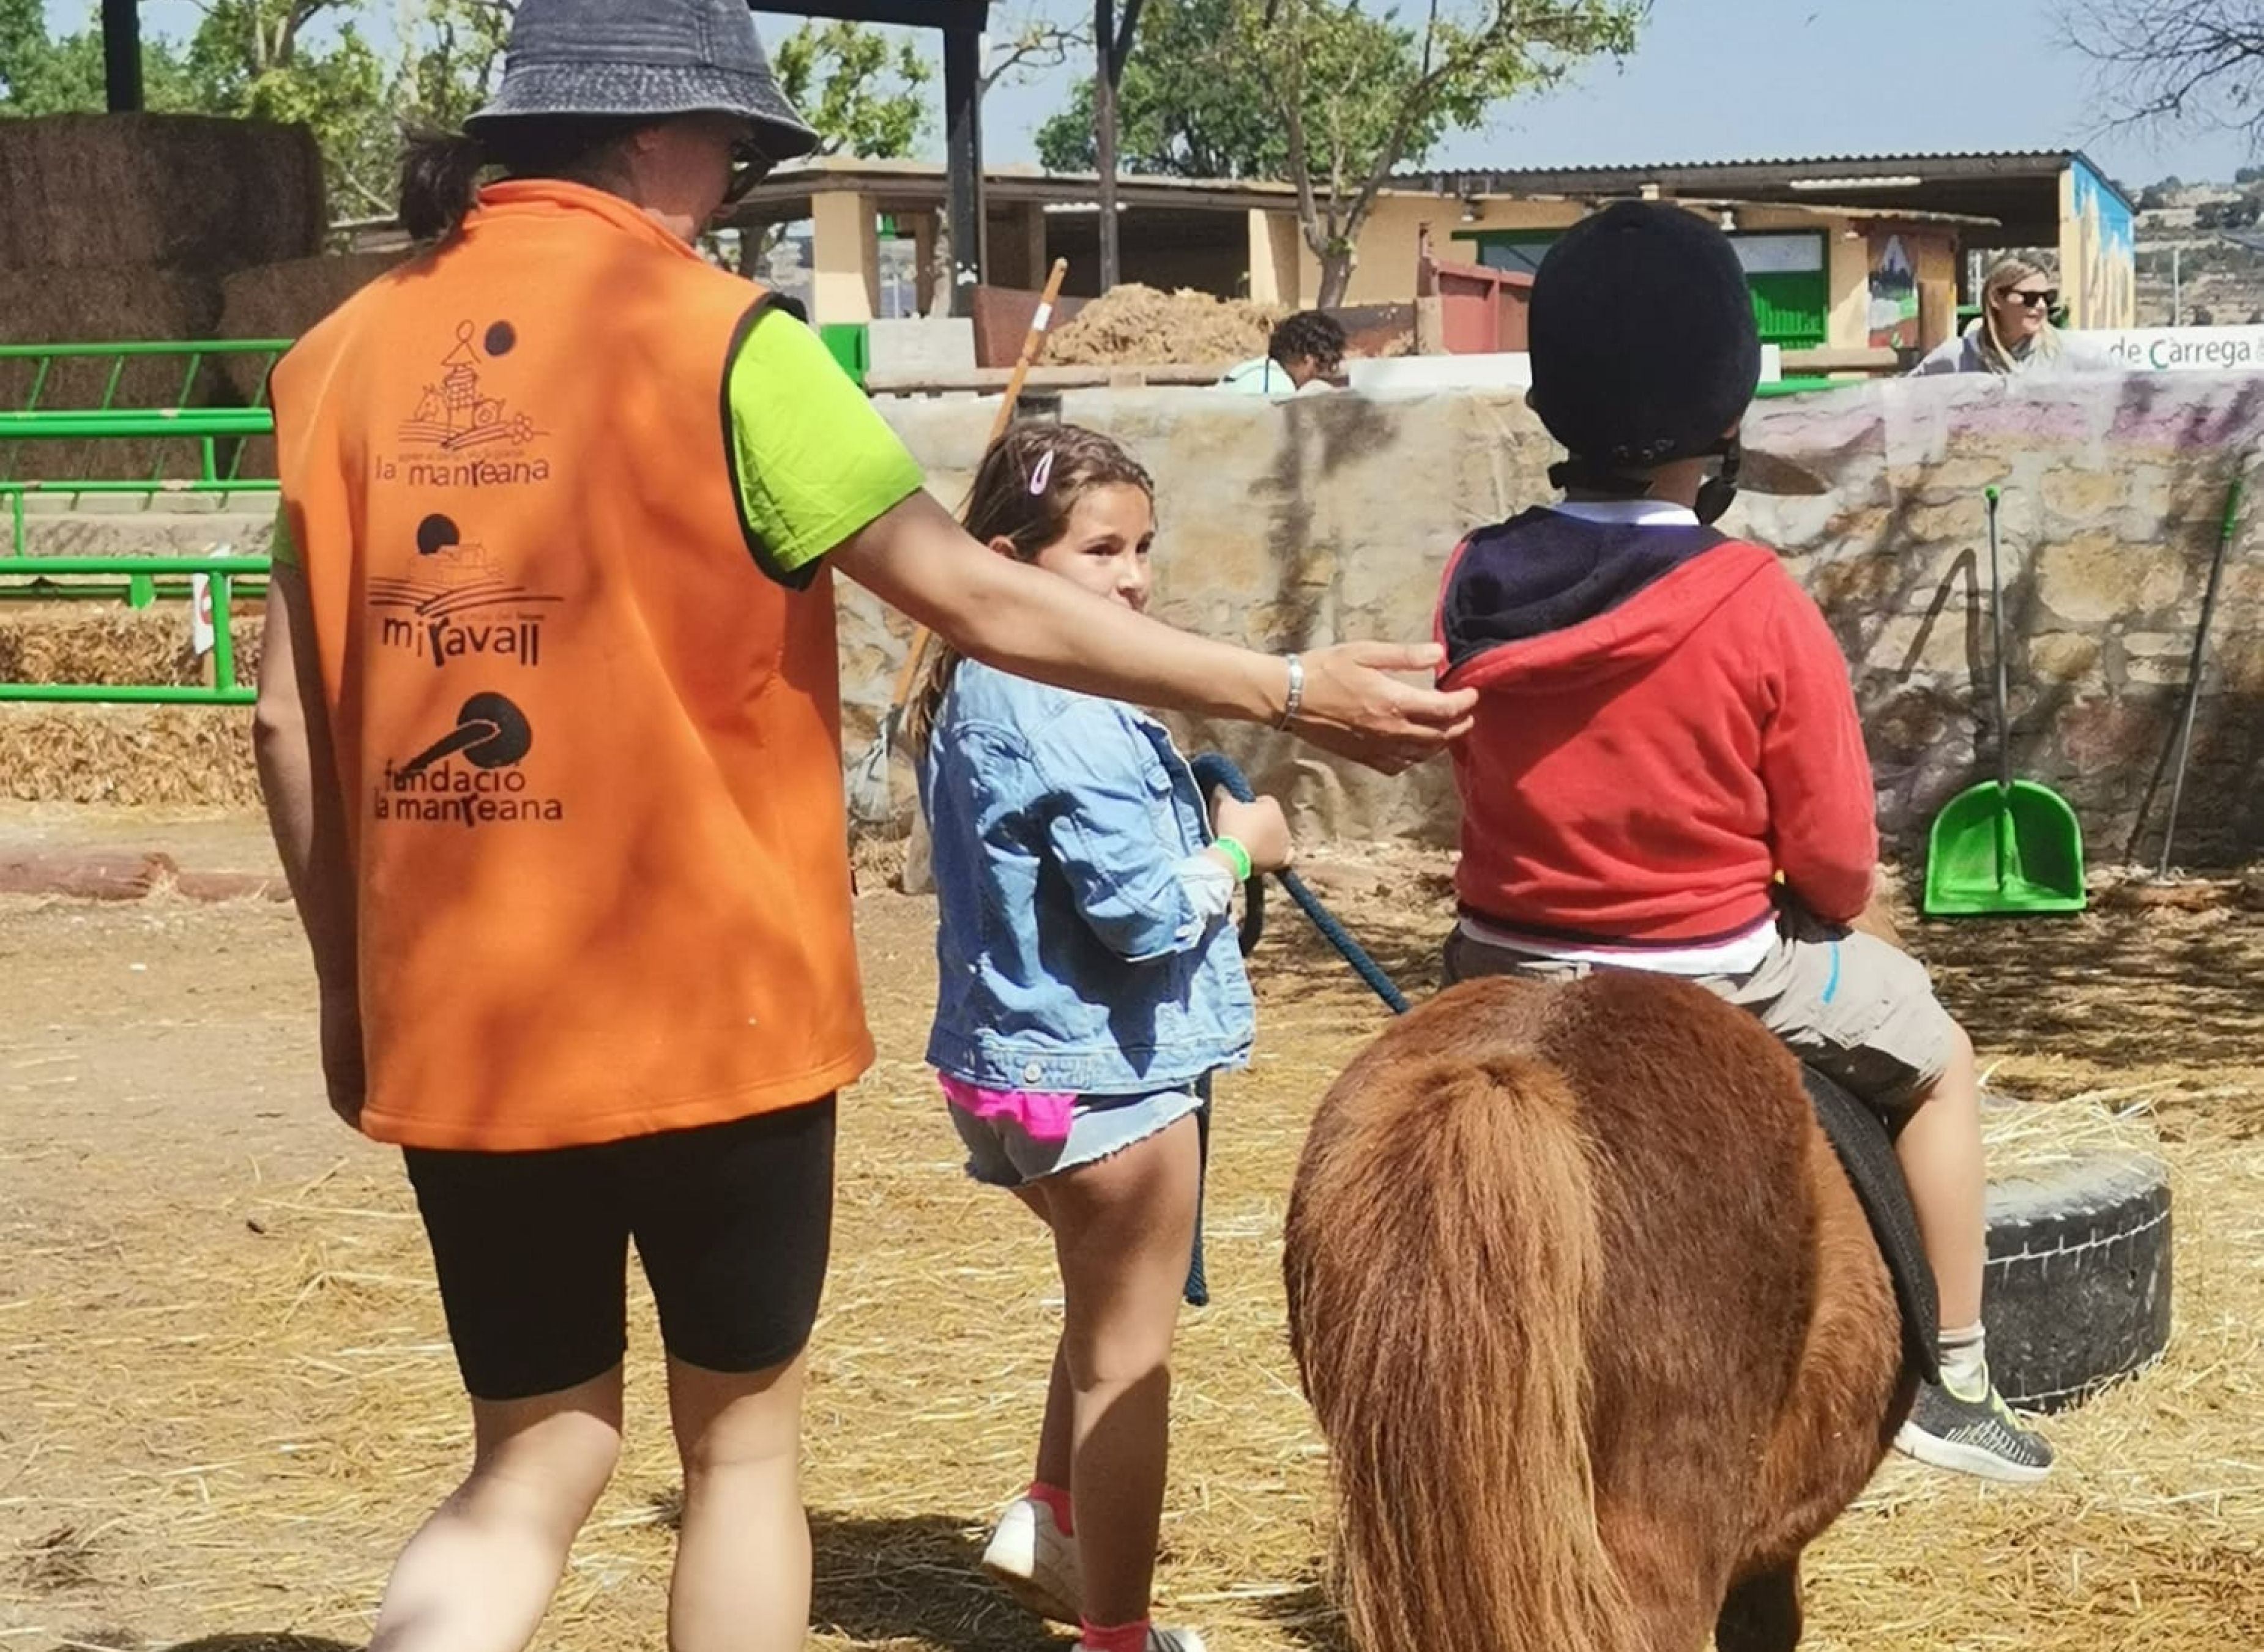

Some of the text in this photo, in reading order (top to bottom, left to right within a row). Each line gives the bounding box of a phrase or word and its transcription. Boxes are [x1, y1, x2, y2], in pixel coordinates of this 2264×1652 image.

[2110, 336, 2141, 363] de
[375, 455, 396, 480] la
[408, 458, 549, 488] manreana
[383, 616, 539, 667] miravall
[374, 787, 562, 827] la manreana
